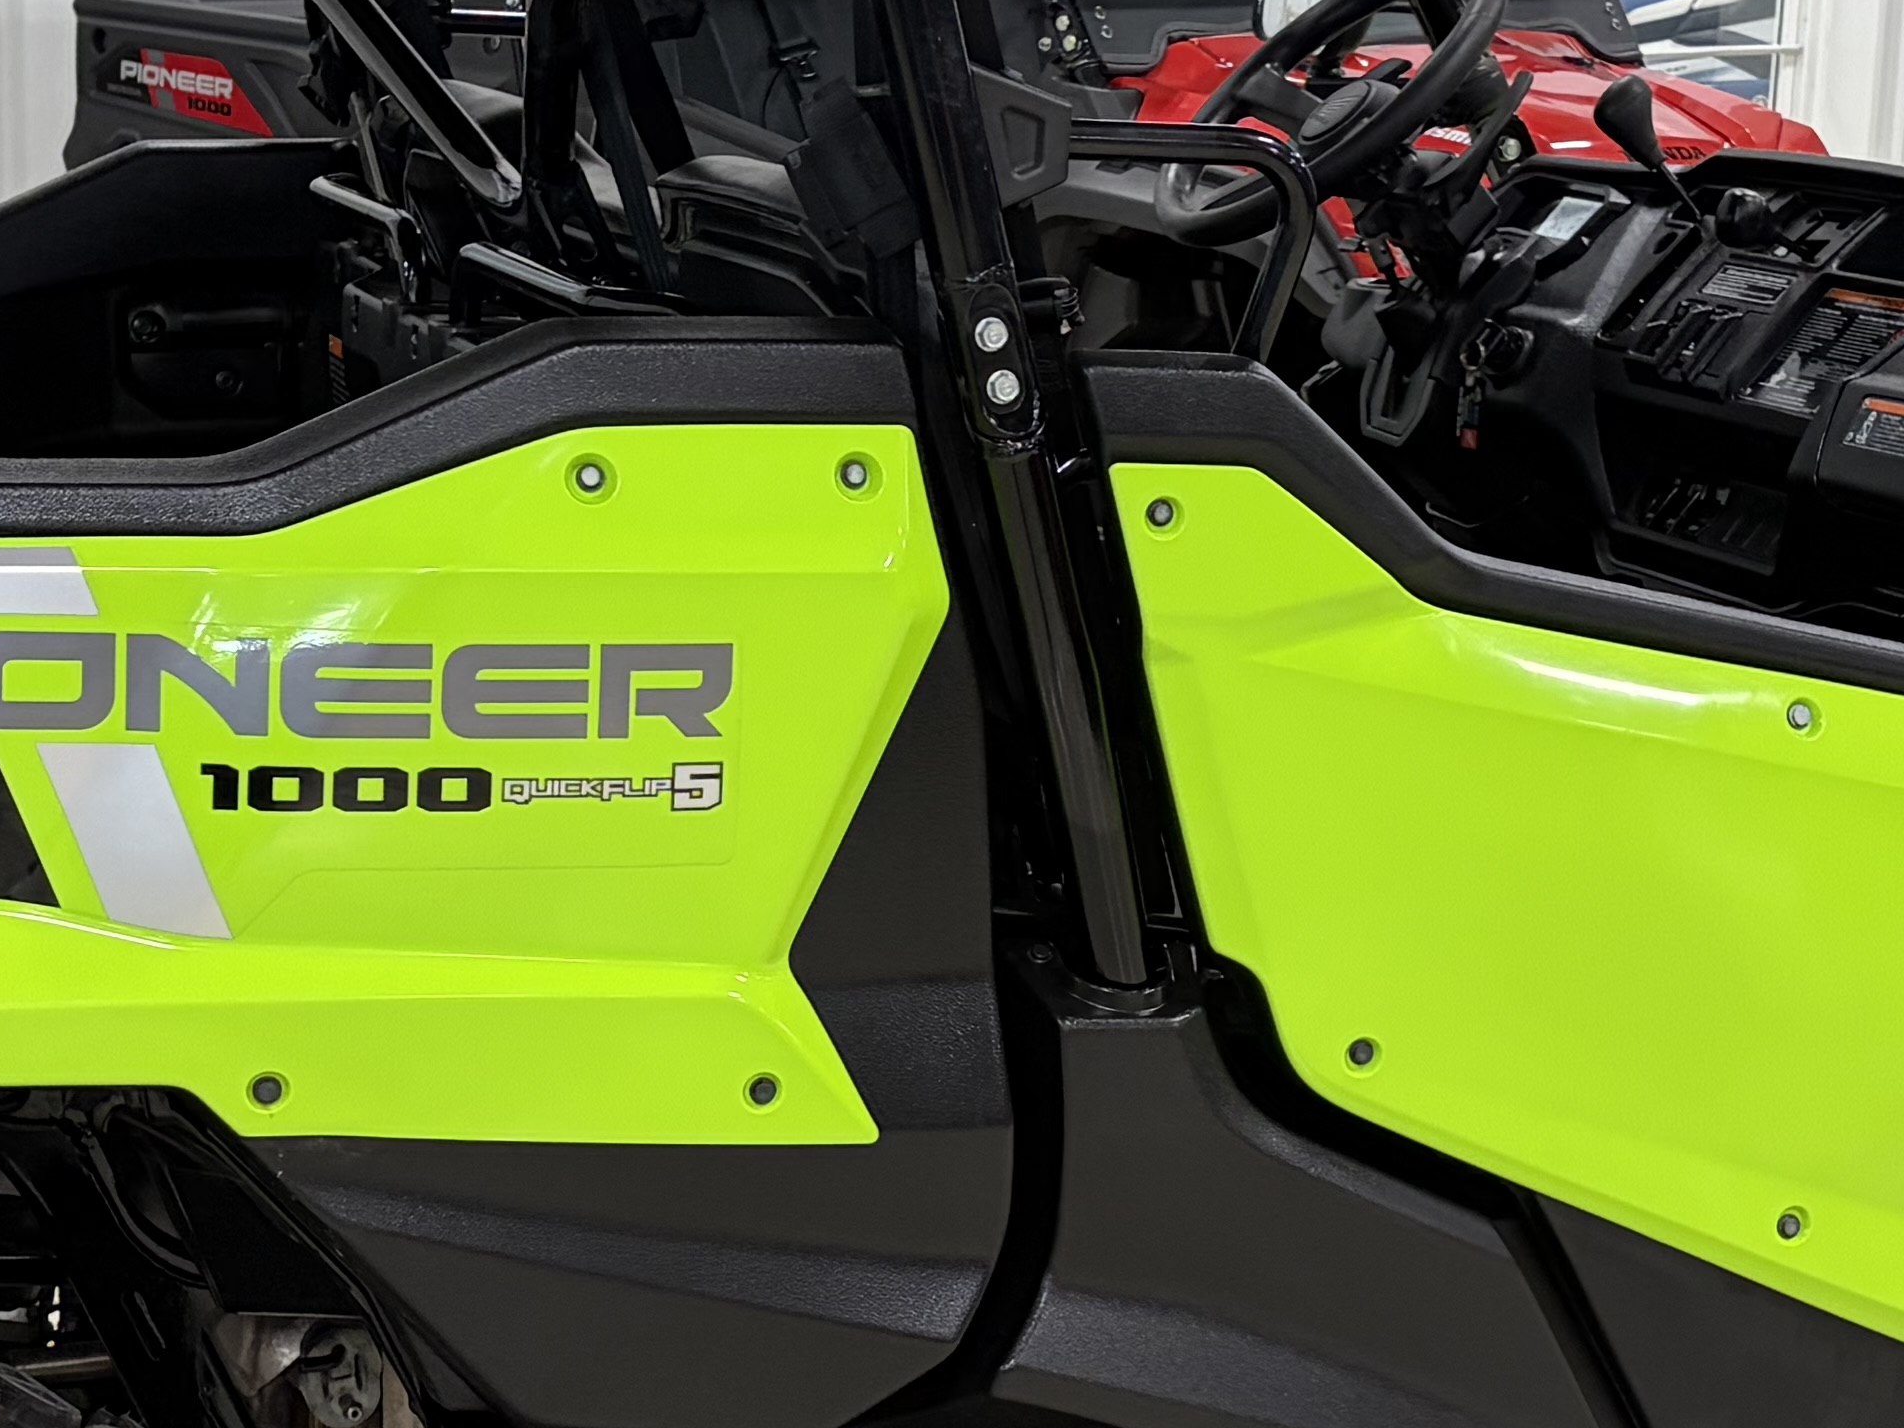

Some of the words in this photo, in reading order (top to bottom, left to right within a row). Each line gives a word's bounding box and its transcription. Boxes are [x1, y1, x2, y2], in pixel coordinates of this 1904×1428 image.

[119, 59, 234, 100] PIONEER
[187, 96, 232, 117] 1000
[199, 761, 493, 813] 1000
